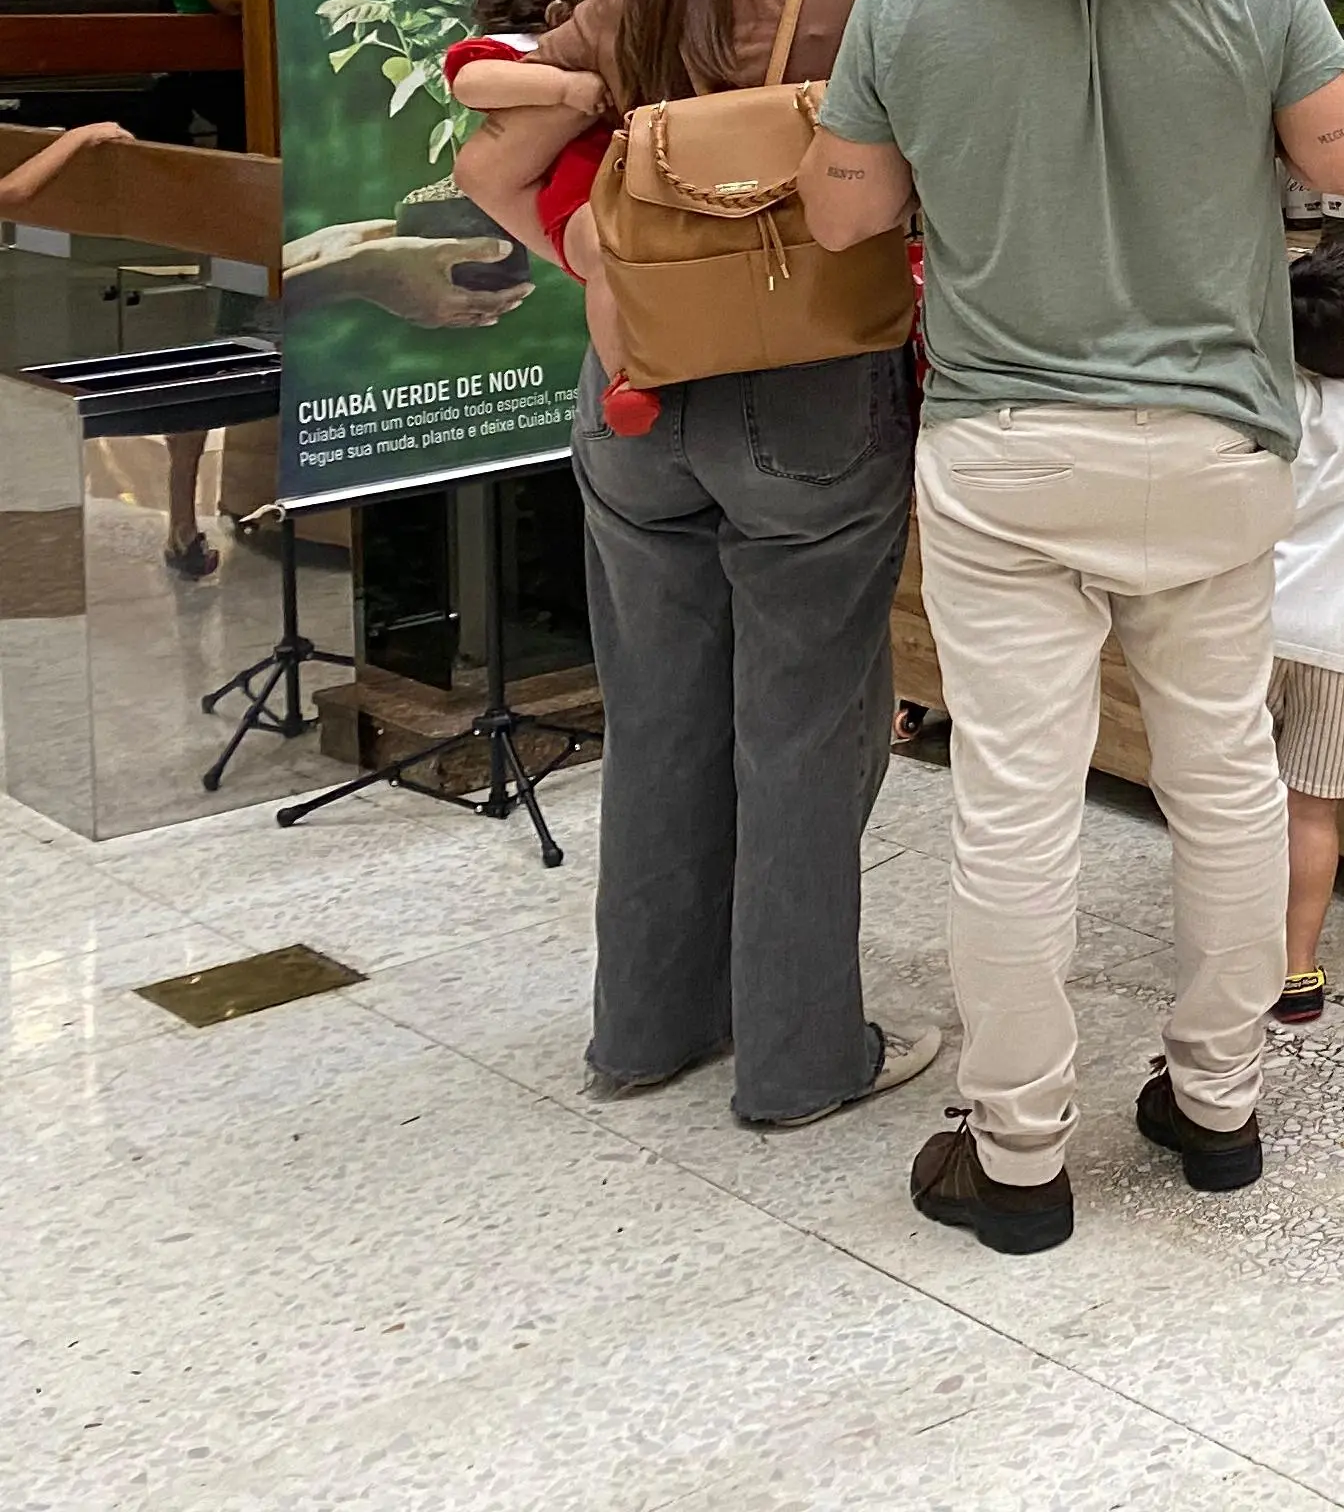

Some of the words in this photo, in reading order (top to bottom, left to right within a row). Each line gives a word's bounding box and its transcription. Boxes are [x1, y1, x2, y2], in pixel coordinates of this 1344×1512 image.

[299, 385, 378, 425] CUIABÁ
[382, 379, 450, 410] VERDE
[456, 374, 483, 399] DE
[489, 365, 544, 394] NOVO
[299, 424, 347, 446] Cuiabá
[349, 419, 378, 437] tem
[381, 416, 404, 433] um
[406, 405, 461, 428] colorido
[463, 401, 494, 419] todo
[496, 389, 553, 414] especial,
[300, 447, 344, 468] Pegue
[347, 443, 373, 459] sua
[377, 435, 419, 455] muda,
[422, 425, 465, 448] plante
[467, 424, 477, 438] e
[480, 416, 516, 436] deixe
[518, 407, 562, 429] Cuiabá
